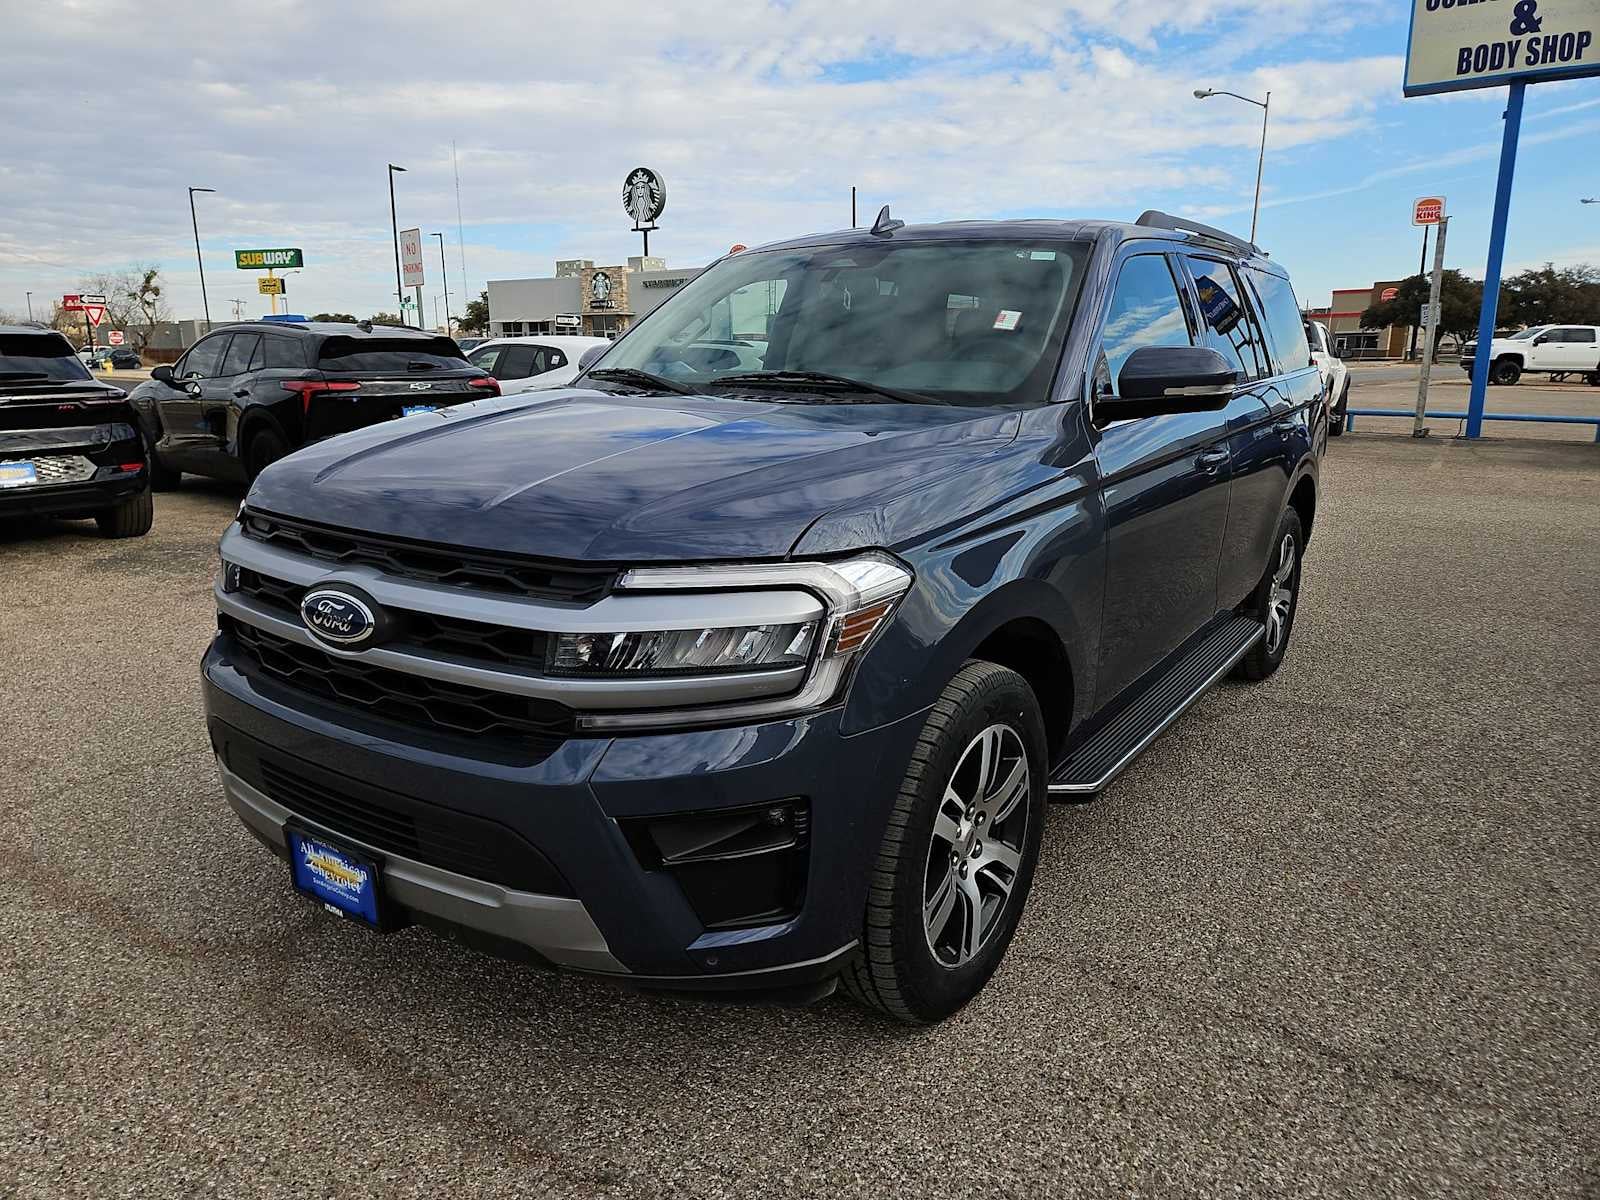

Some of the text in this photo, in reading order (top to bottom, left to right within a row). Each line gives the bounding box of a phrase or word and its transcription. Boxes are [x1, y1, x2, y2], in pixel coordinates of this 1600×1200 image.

[1510, 0, 1542, 36] &
[1456, 30, 1592, 76] BODY SHOP
[1416, 211, 1441, 220] KING
[239, 251, 294, 265] SUBWAY
[405, 242, 416, 256] NO
[313, 600, 353, 632] Ford
[300, 841, 316, 856] All
[310, 861, 361, 895] Chevrolet
